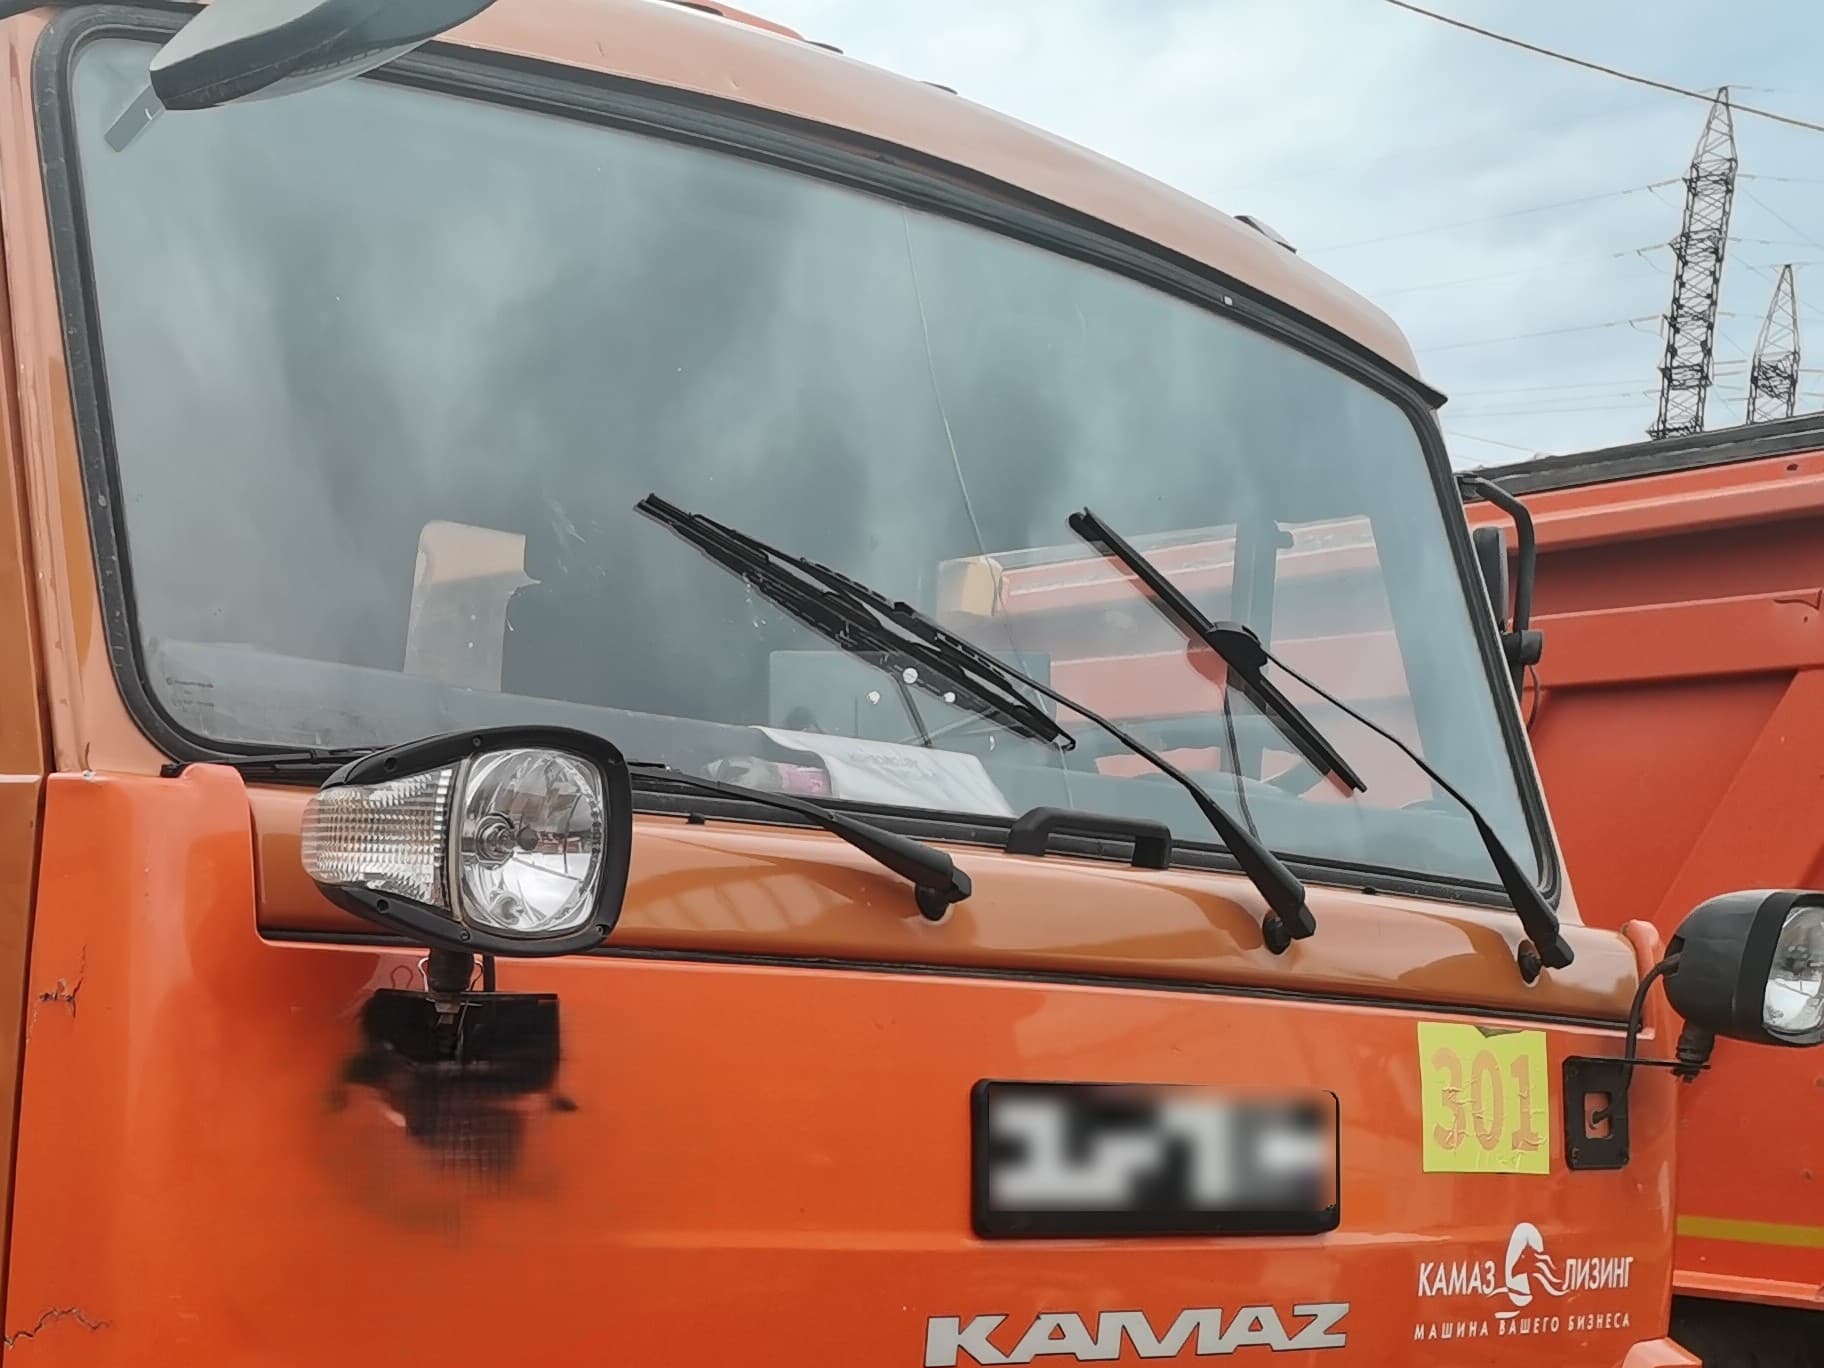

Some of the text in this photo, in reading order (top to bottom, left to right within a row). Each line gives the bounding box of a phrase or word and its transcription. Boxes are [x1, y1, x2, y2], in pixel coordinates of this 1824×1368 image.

[1432, 1047, 1539, 1151] 301
[1418, 1257, 1634, 1297] КАМАЗ ЛИЗИНГ
[923, 1302, 1351, 1368] KAMAZ
[1414, 1312, 1630, 1340] МАШИНА ВАШЕГО БИЗНЕСА
